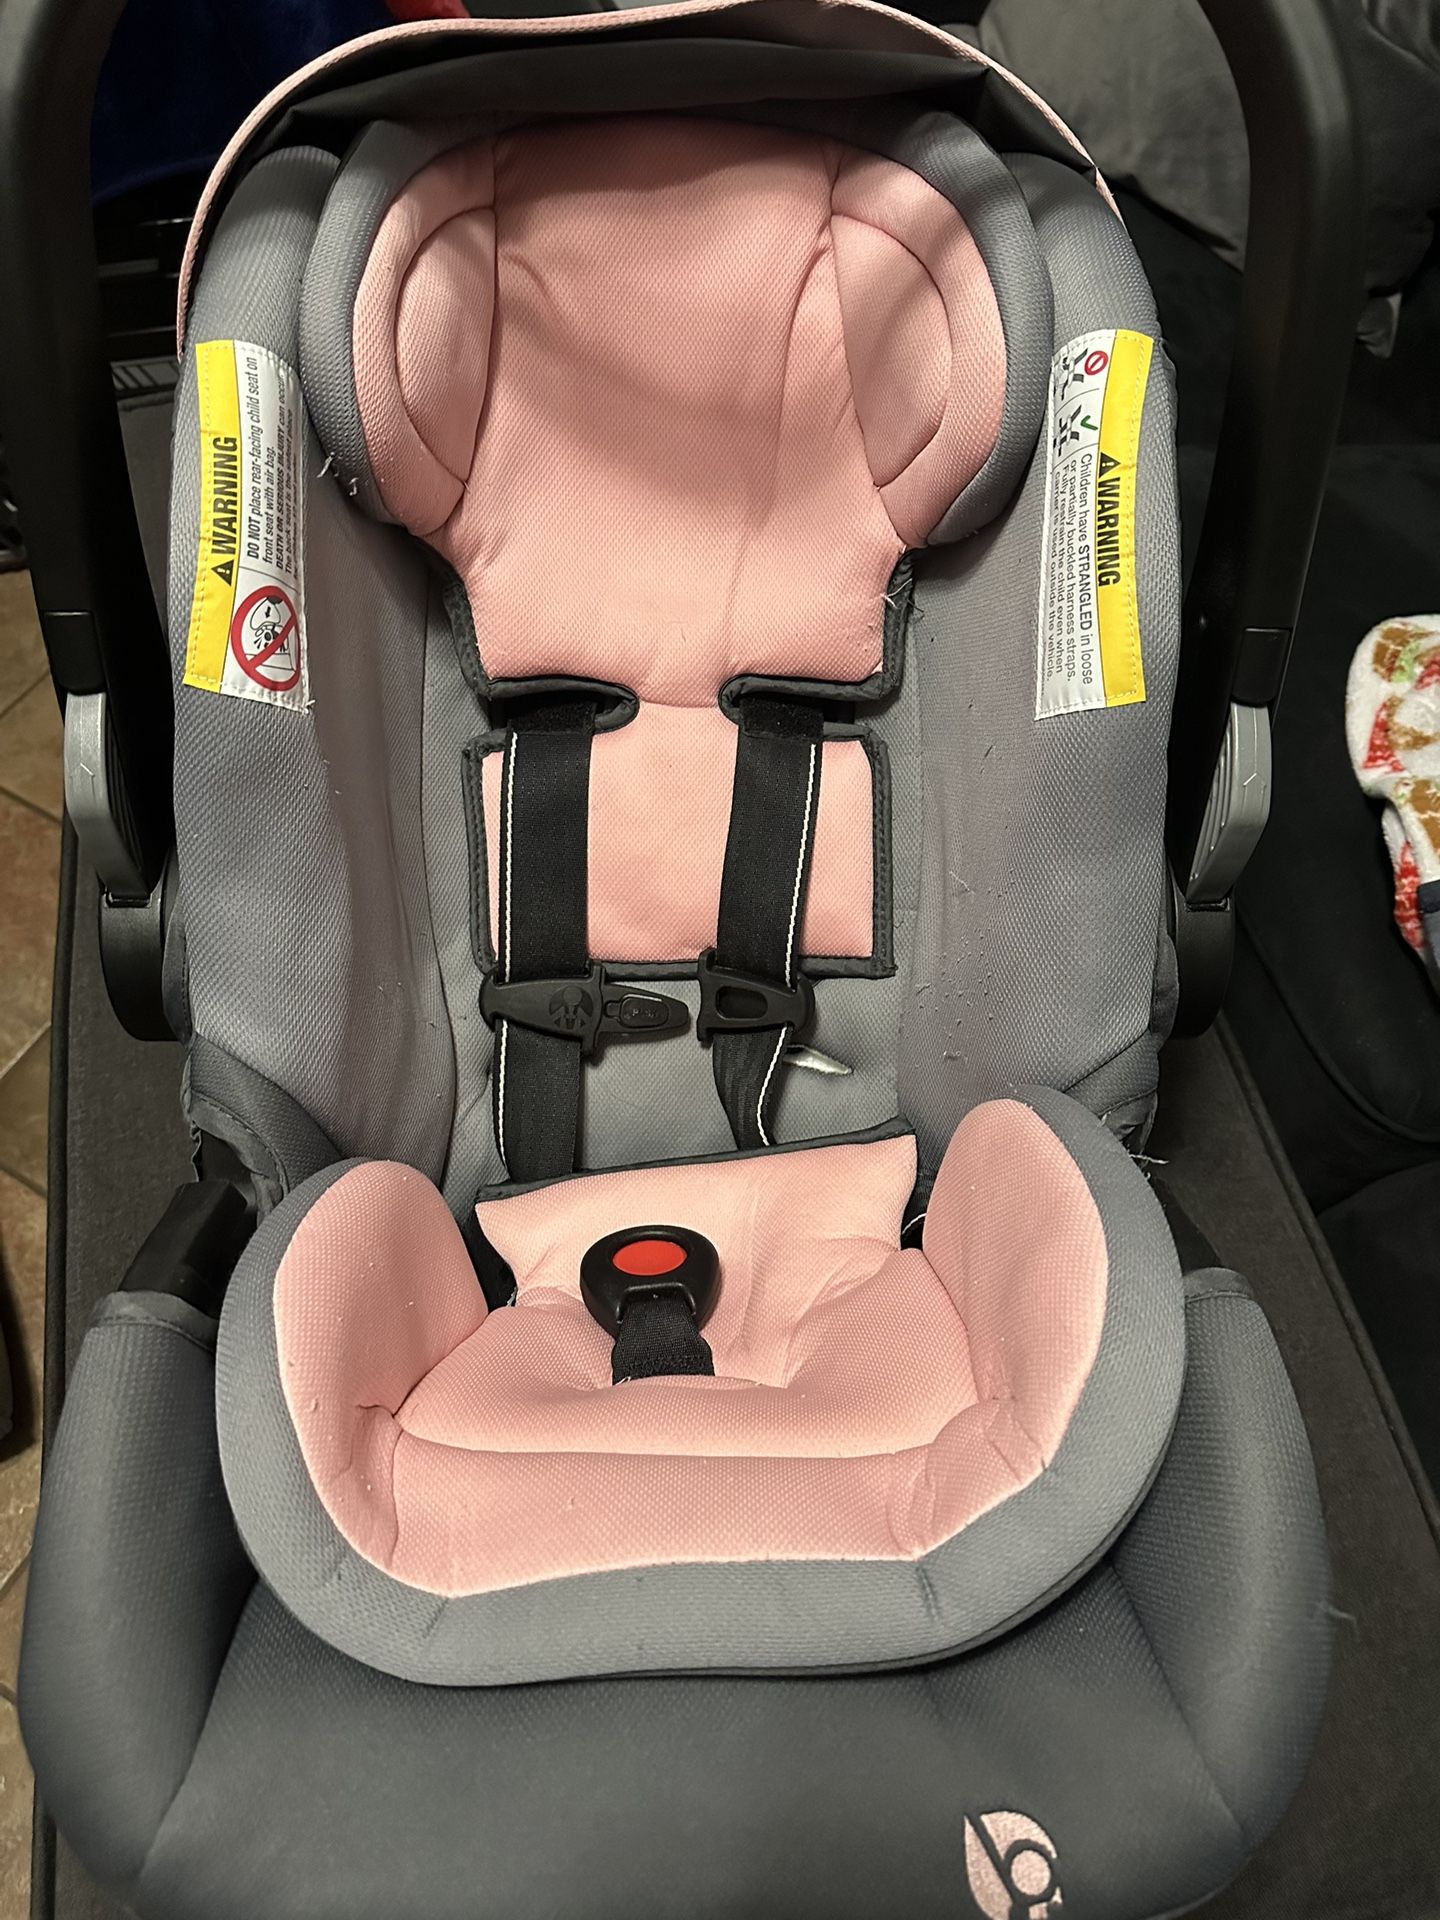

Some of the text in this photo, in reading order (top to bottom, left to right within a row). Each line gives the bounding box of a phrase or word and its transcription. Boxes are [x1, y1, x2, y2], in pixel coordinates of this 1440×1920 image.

[244, 356, 263, 559] DO NOT place rear-facing child seat on
[277, 425, 285, 467] INJURY
[211, 437, 238, 555] WARNING
[262, 446, 276, 564] front seat with air bag.
[276, 467, 284, 515] SERIOUS
[276, 516, 284, 533] OR
[1053, 513, 1059, 525] is
[1097, 477, 1121, 587] WARNING
[276, 534, 284, 570] DEATH
[1050, 528, 1058, 559] used
[1048, 561, 1057, 608] outside
[1055, 464, 1070, 674] Fully restrain the child even when
[1064, 459, 1077, 682] or partially buckled harness straps.
[1078, 453, 1094, 685] Children have STRANGLED in loose
[1048, 611, 1056, 631] the
[1046, 633, 1055, 682] vehicle.
